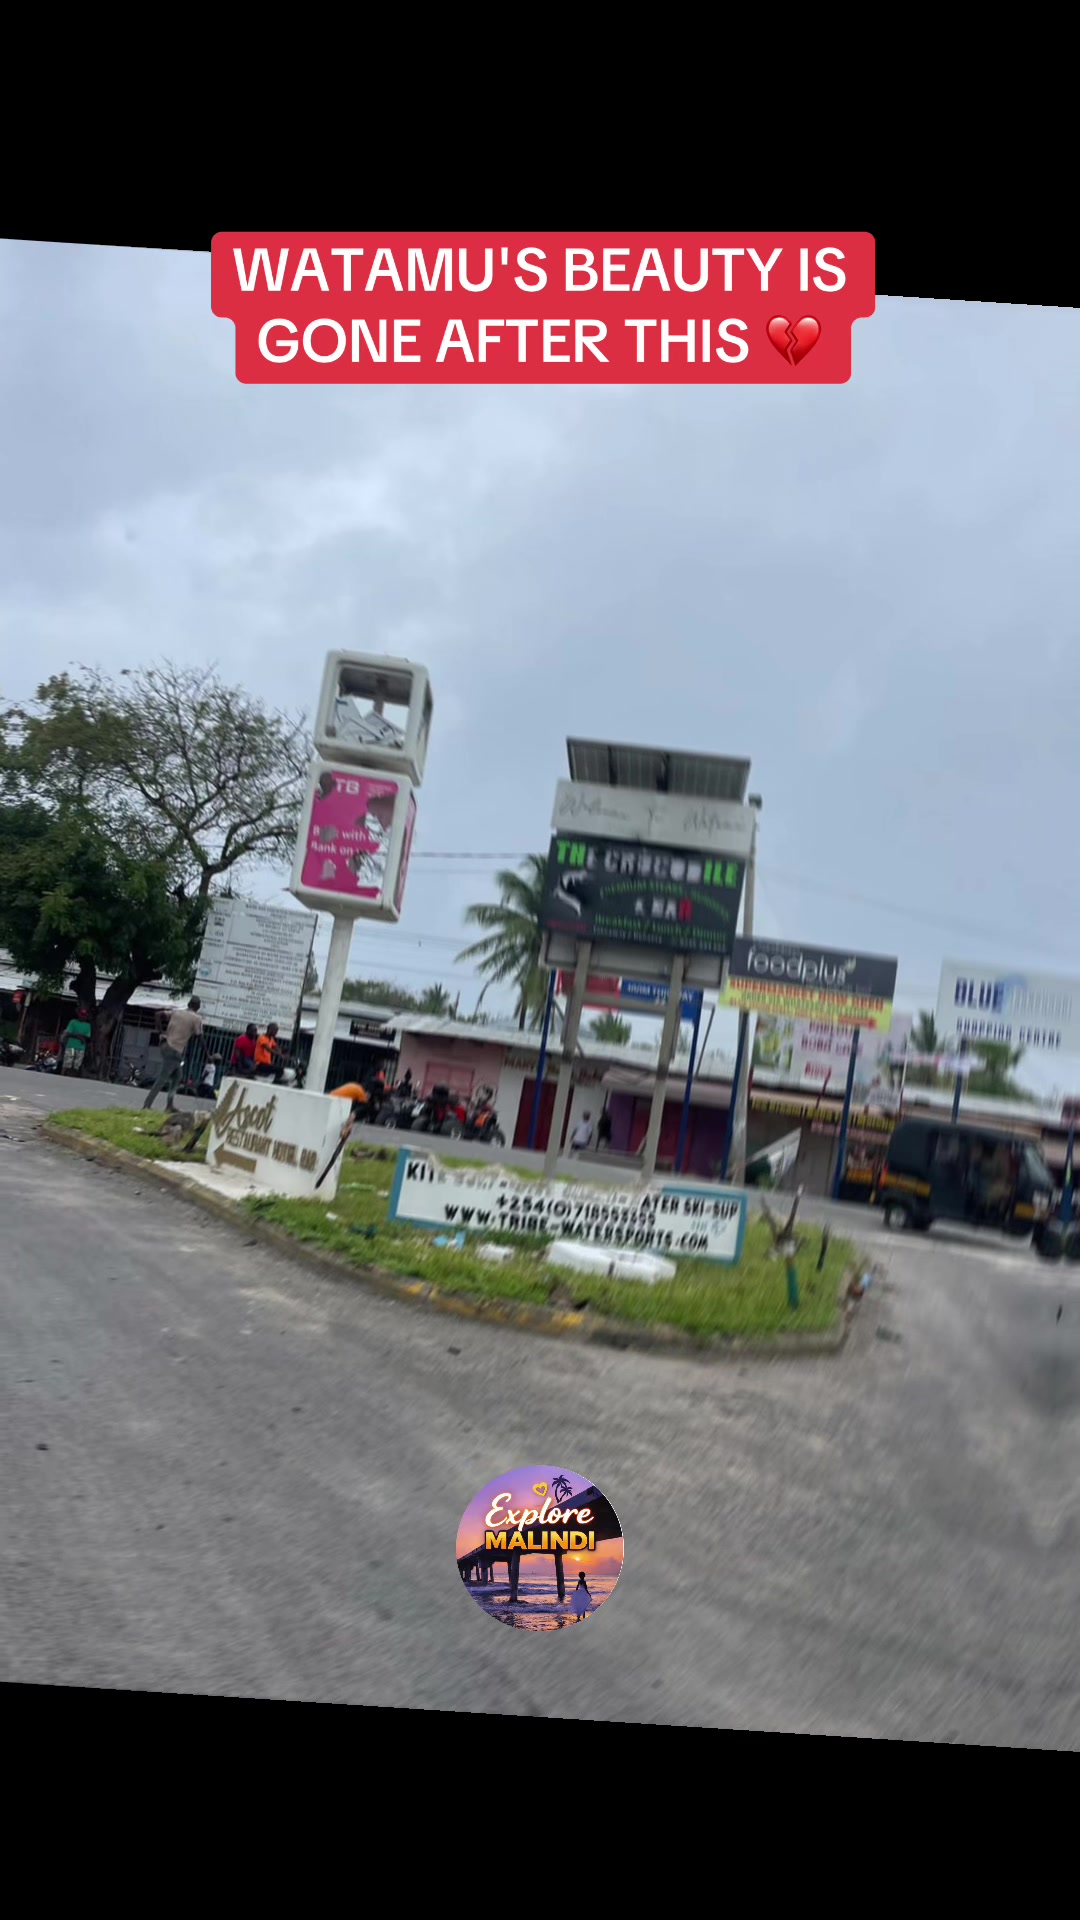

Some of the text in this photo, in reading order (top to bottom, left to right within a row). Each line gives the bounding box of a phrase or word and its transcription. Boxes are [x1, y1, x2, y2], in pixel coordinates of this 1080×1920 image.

[342, 829, 366, 842] with
[747, 949, 847, 986] foodplus
[954, 976, 1004, 1014] BLUE
